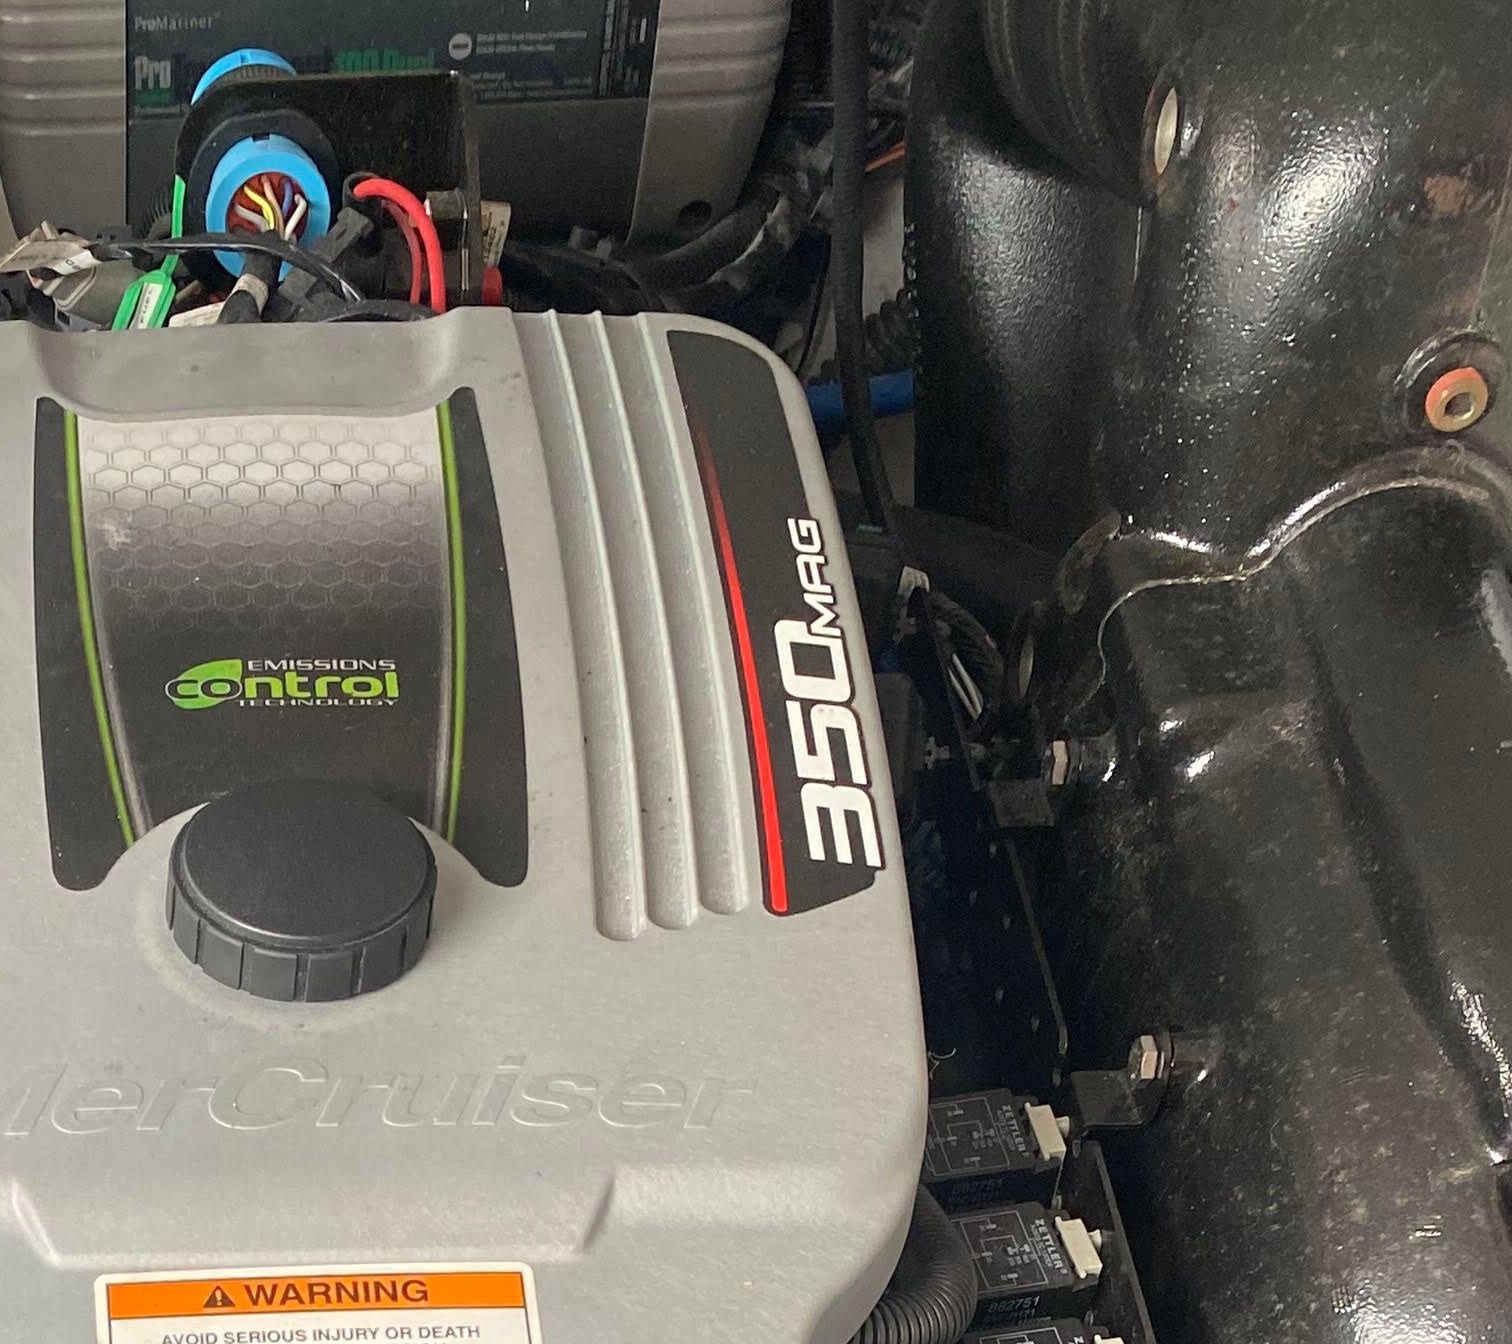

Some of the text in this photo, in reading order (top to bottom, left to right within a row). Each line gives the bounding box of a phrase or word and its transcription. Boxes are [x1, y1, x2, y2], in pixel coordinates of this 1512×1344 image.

[247, 658, 396, 671] EMISSIONS
[773, 517, 884, 868] 350 MAG
[1034, 1218, 1063, 1269] ZETTLER
[244, 1278, 430, 1307] WARNING
[224, 1328, 307, 1344] SERIOUS
[312, 1326, 379, 1343] INJURY
[385, 1326, 412, 1341] OR
[418, 1325, 481, 1340] DEATH
